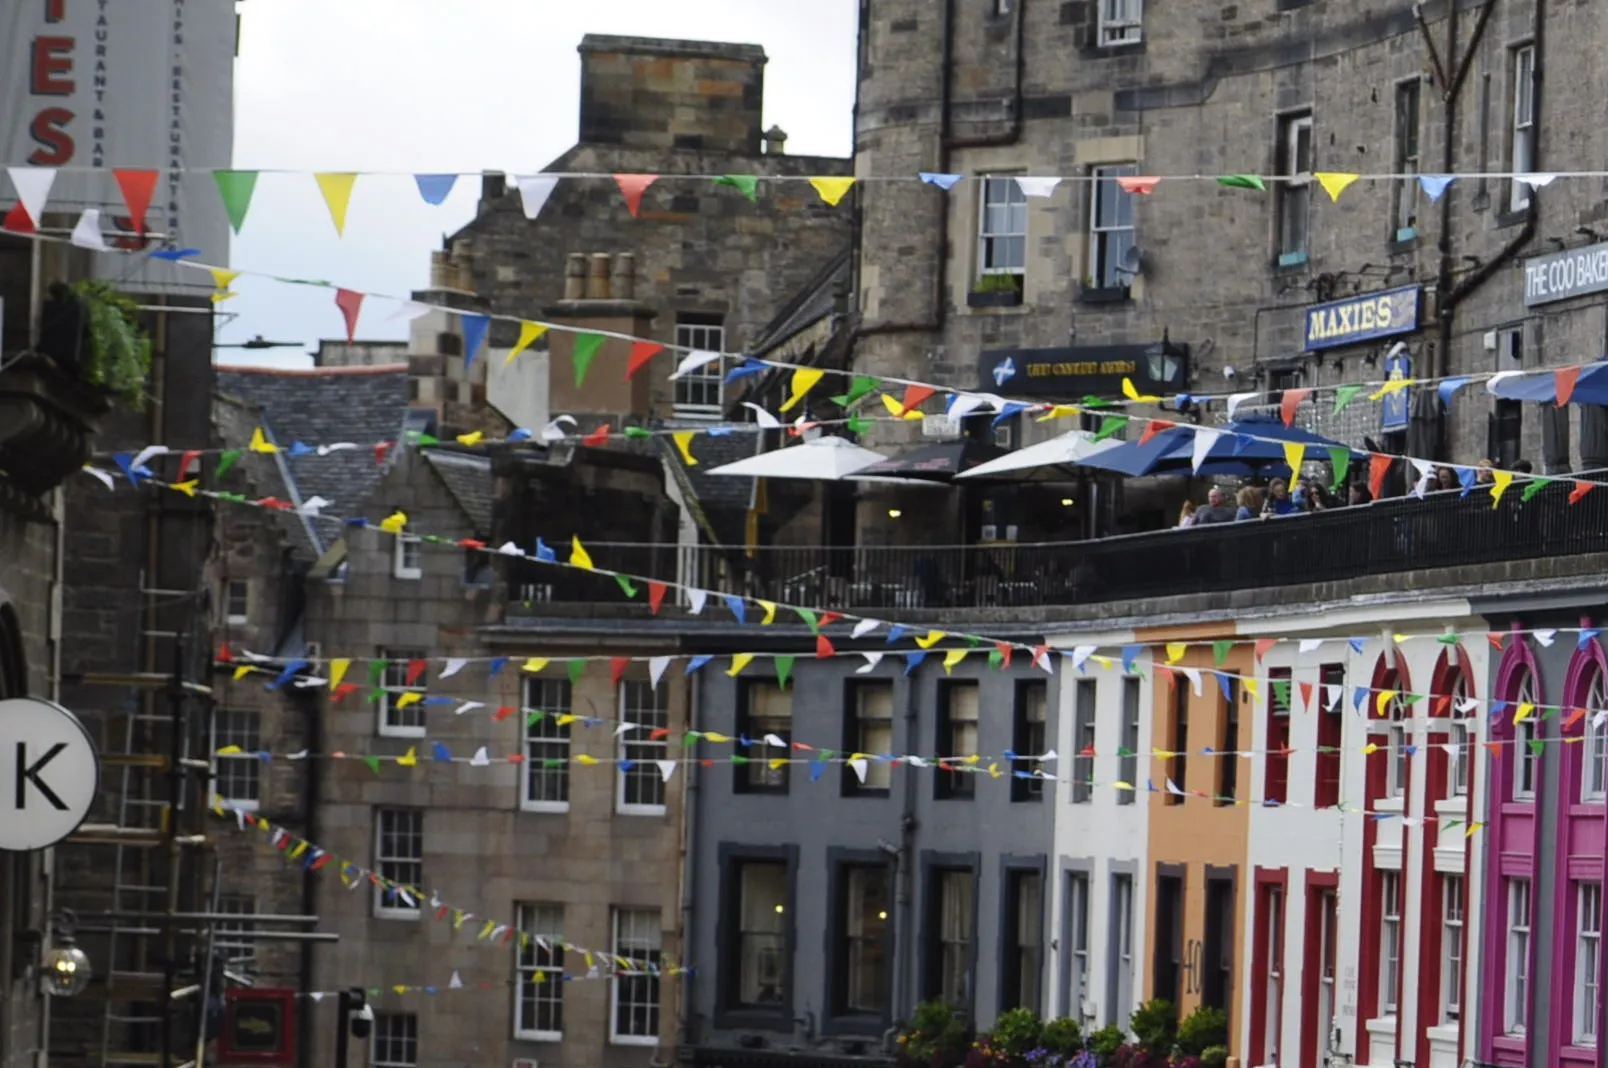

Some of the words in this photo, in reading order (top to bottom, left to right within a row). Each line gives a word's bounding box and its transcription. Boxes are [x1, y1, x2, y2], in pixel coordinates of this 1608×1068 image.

[1526, 264, 1548, 297] THE
[1549, 258, 1574, 293] COO
[1309, 296, 1392, 341] MAXIES
[15, 741, 71, 811] K
